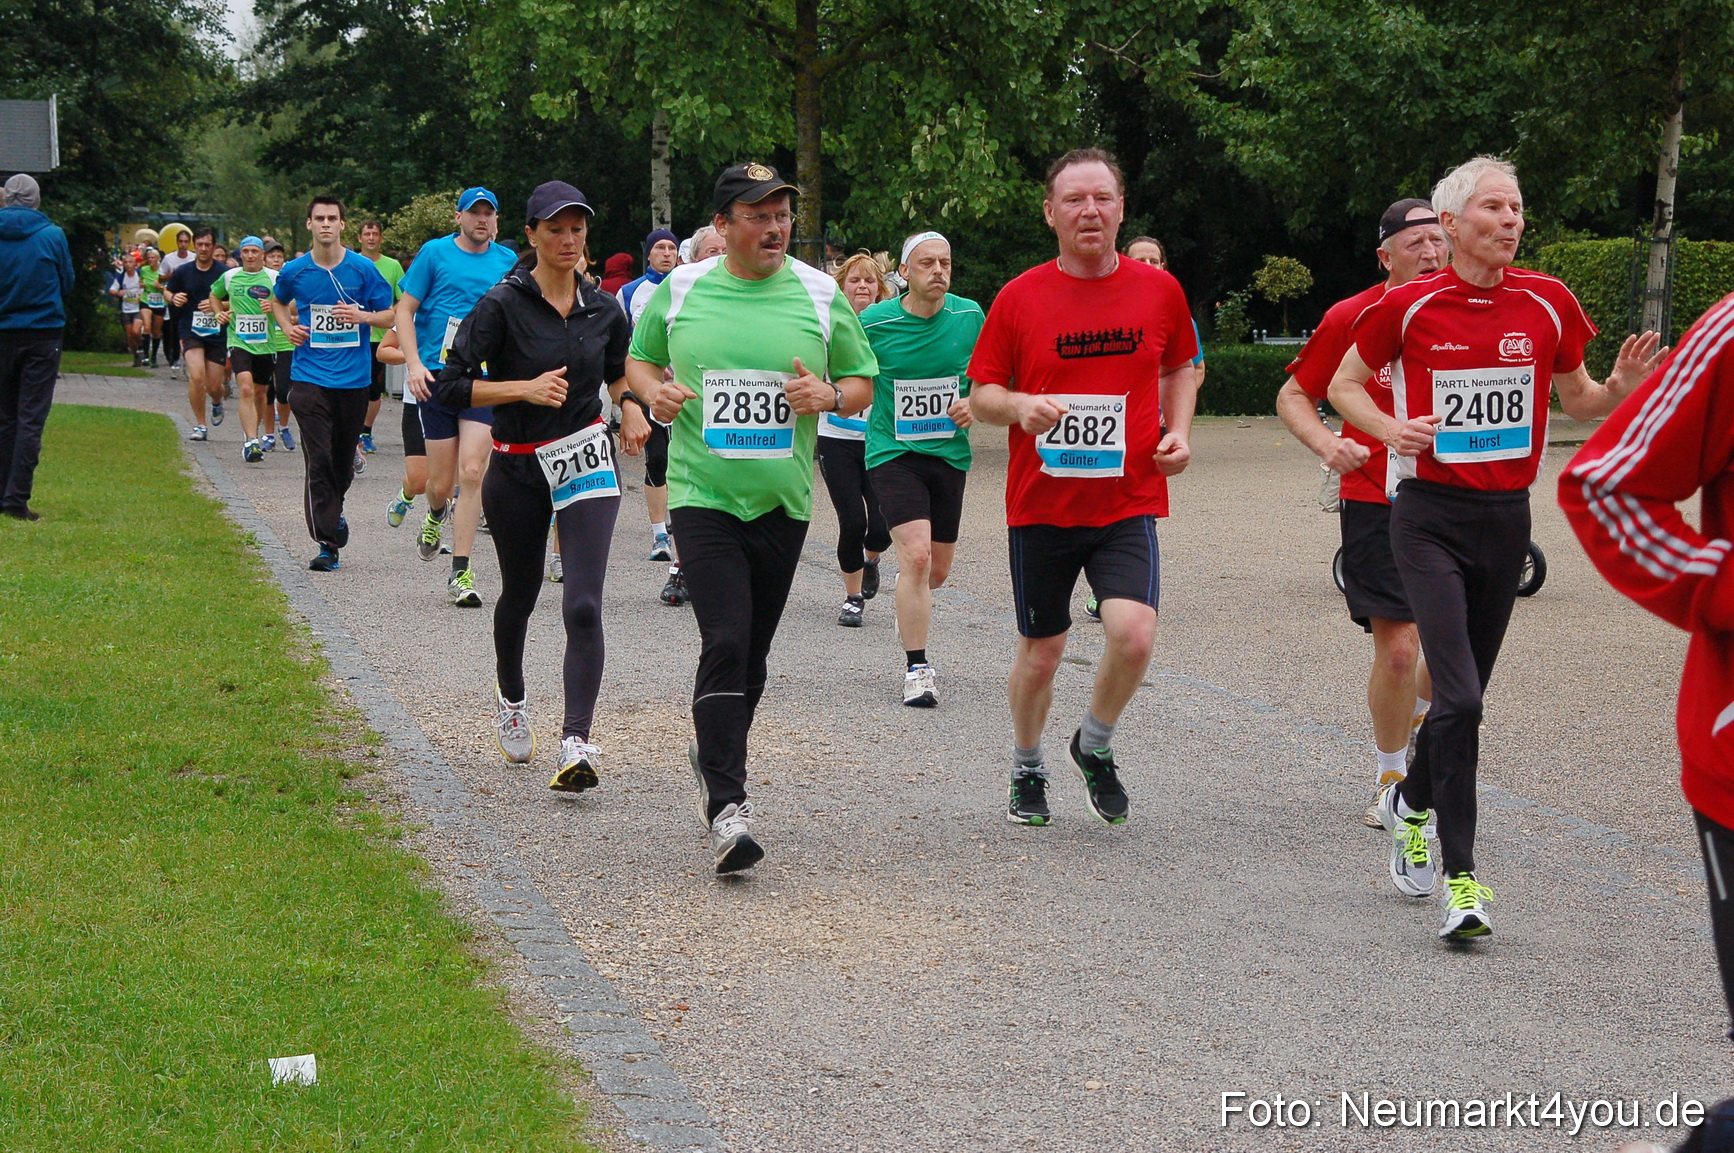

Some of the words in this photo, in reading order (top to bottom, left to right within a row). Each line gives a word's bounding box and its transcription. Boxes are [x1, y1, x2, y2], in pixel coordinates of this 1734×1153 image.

[196, 317, 217, 328] 2923
[239, 321, 265, 332] 2150
[1061, 345, 1082, 356] RUN
[1083, 342, 1101, 354] FOR
[705, 378, 737, 387] PARTL
[739, 378, 783, 389] Neumarkt
[896, 385, 917, 393] PARTL
[918, 384, 949, 392] Neumarkt
[1435, 380, 1469, 388] PARTL
[1471, 377, 1517, 388] Neumarkt
[713, 391, 791, 425] 2836
[901, 392, 954, 417] 2507
[1069, 403, 1111, 412] Neumarkt
[1444, 389, 1523, 427] 2408
[911, 422, 946, 432] Rüdiger
[1045, 415, 1117, 446] 2682
[566, 432, 600, 453] Neumarkt
[725, 433, 776, 446] Manfred
[1469, 434, 1501, 449] Horst
[552, 439, 610, 486] 2184
[1060, 452, 1099, 466] Günter
[569, 476, 606, 494] Barbara
